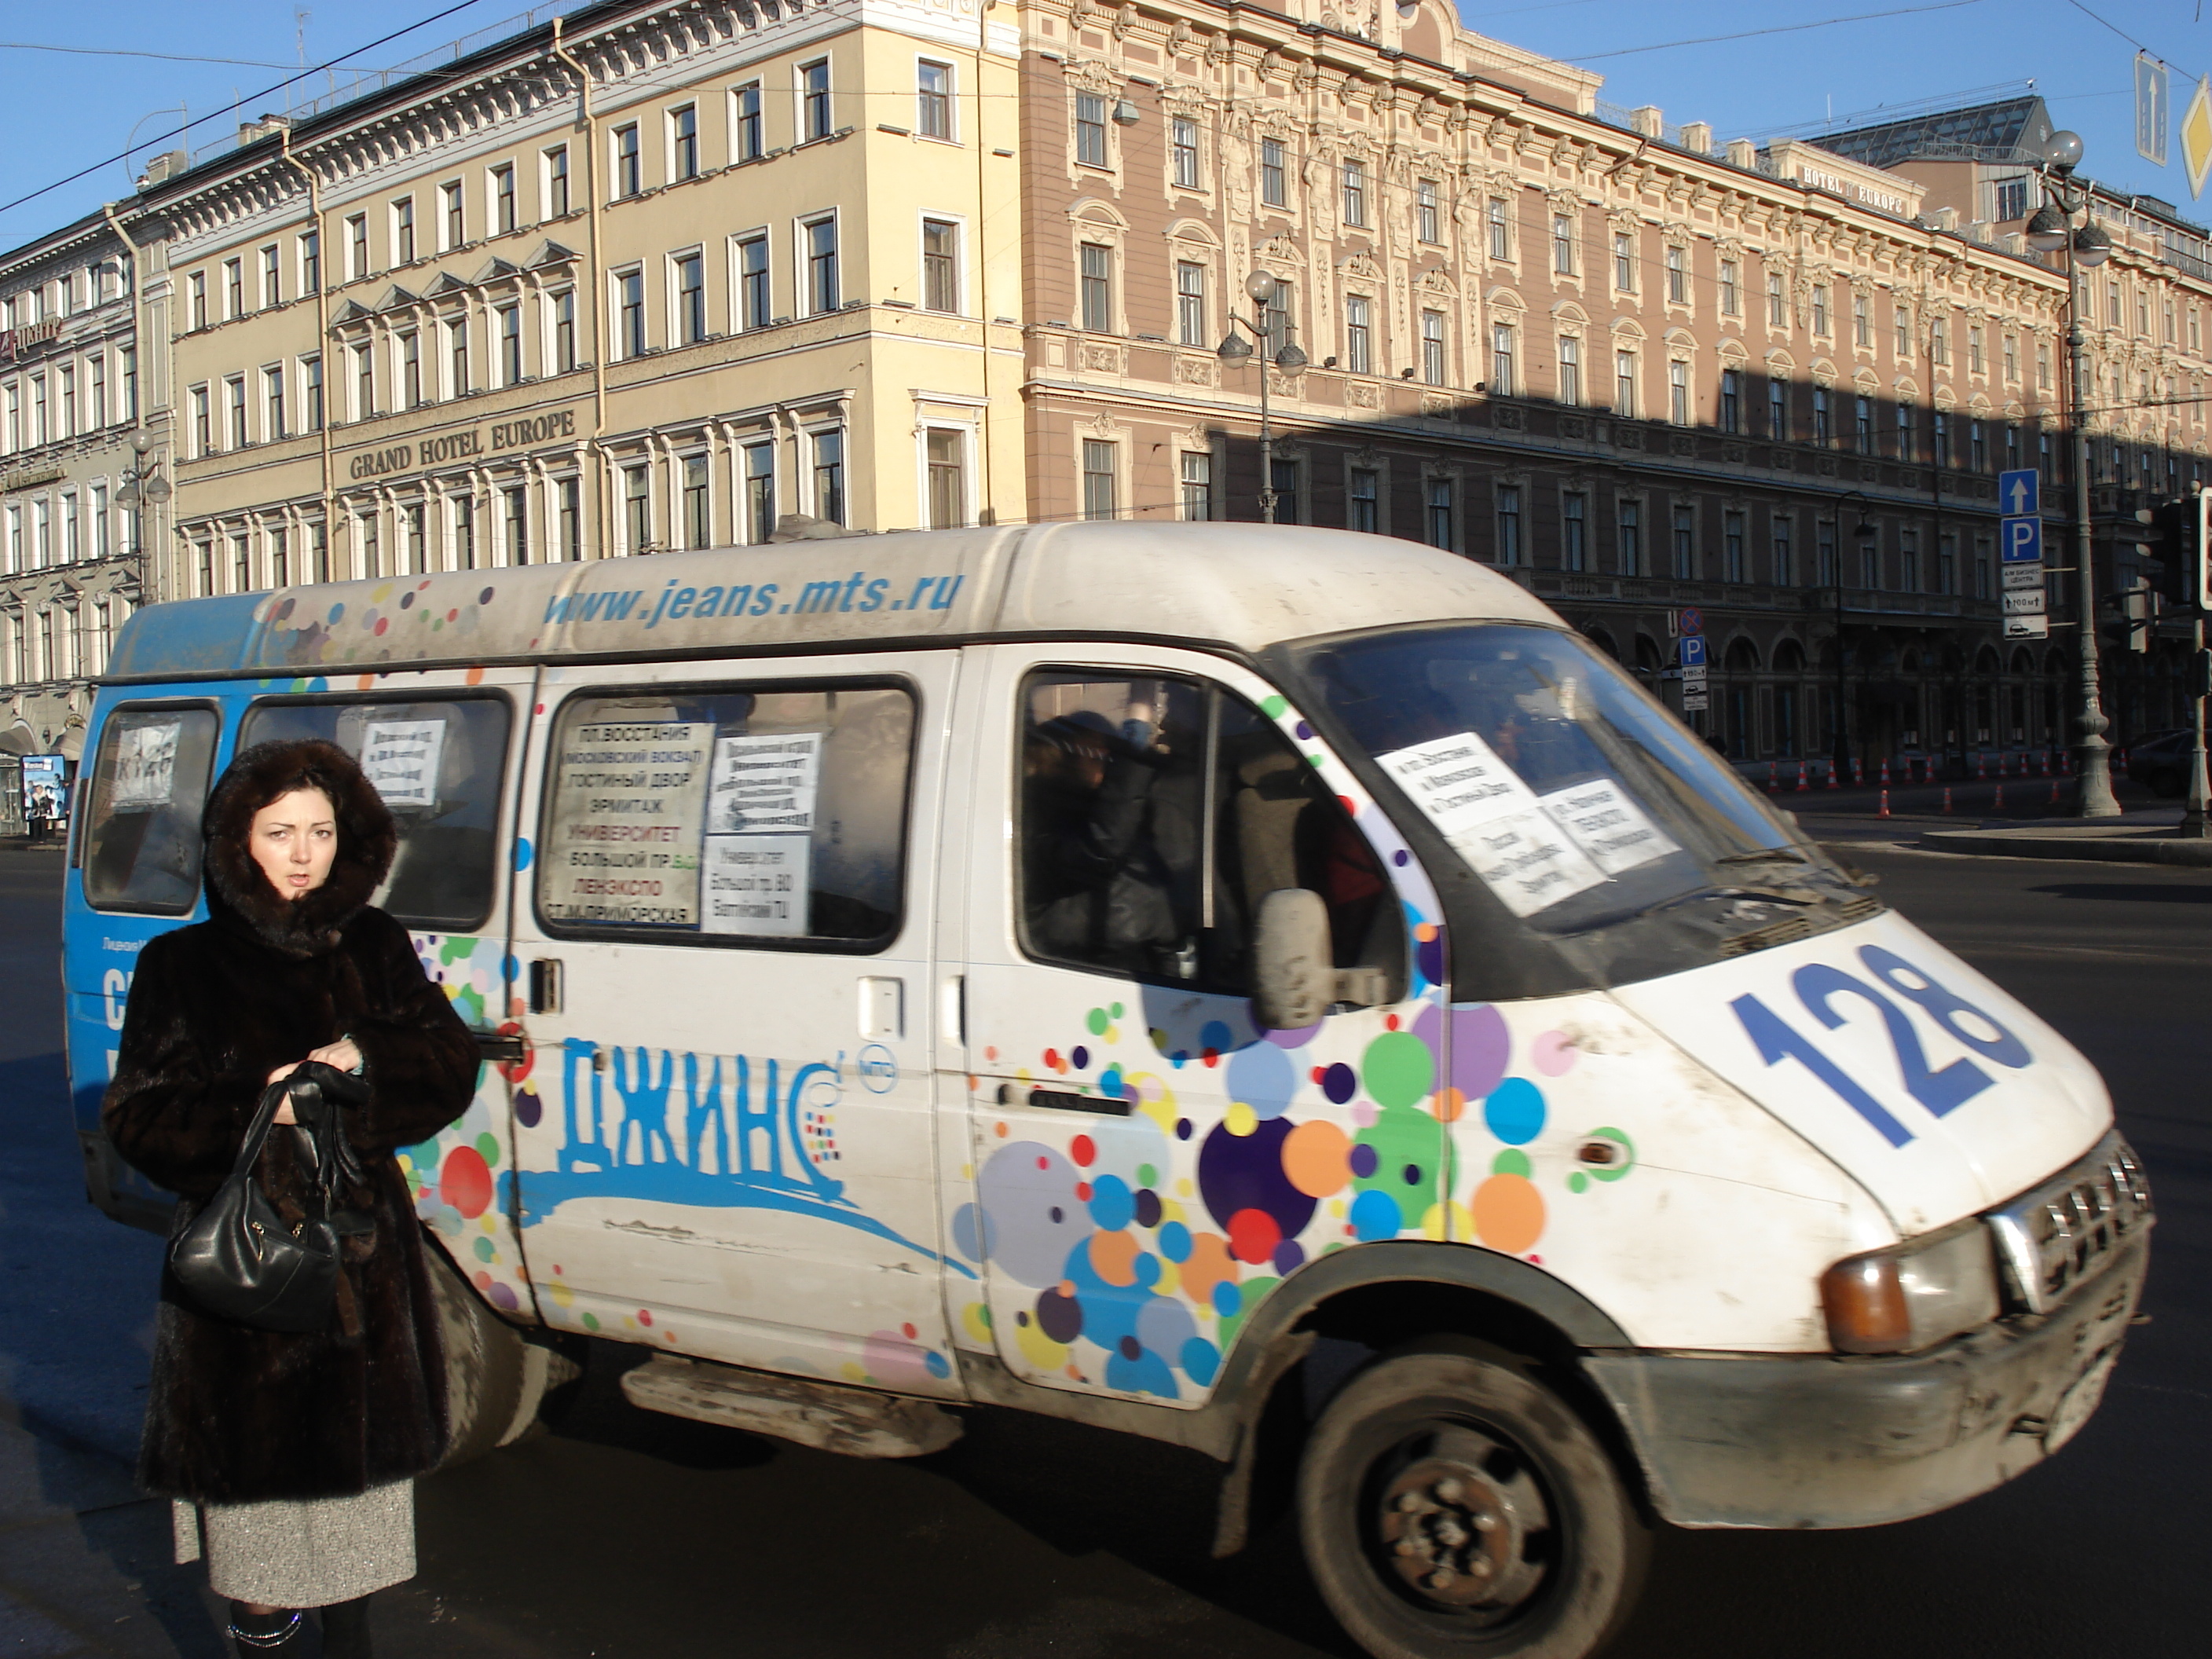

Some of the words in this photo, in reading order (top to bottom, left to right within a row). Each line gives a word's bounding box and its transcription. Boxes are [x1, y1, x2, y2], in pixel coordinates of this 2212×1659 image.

[1804, 167, 1843, 194] HOTEL
[1858, 185, 1903, 214] EUROPE
[350, 445, 412, 479] GRAND
[419, 430, 484, 465] HOTEL
[491, 409, 576, 451] EUROPE
[2012, 522, 2034, 557] P
[544, 571, 965, 629] www.jeans.mts.ru
[1686, 639, 1701, 663] P
[569, 770, 649, 788] ГОСТИНЫЙ
[649, 773, 690, 790] ДВОР
[589, 799, 664, 814] ЭРМИТАЖ
[566, 824, 682, 843] УНИВЕРСИТЕТ
[569, 850, 648, 869] БОЛЬШОЙ
[572, 878, 664, 896] ЛЕНЭКСПО
[1729, 944, 2034, 1148] 128
[557, 1037, 845, 1203] ДЖИНС
